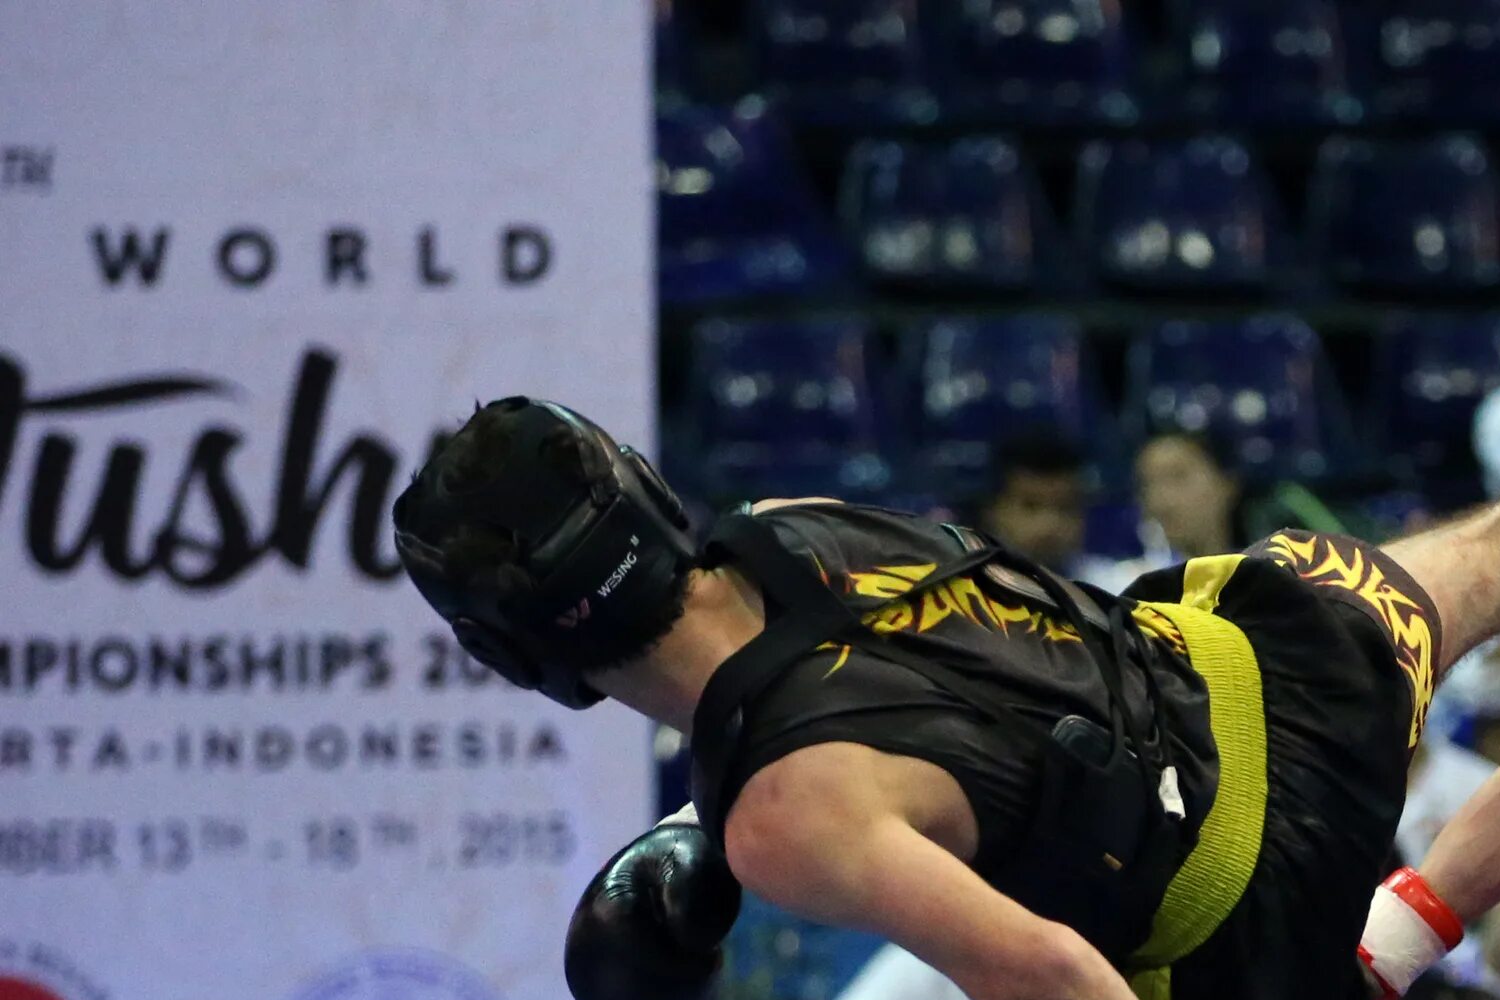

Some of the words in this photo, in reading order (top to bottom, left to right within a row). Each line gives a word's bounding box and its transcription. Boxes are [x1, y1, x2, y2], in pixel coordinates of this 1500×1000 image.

[91, 226, 554, 288] WORLD
[0, 343, 455, 588] ush
[597, 551, 637, 597] WESING
[0, 634, 393, 690] PIONSHIPS
[0, 816, 114, 874] BER
